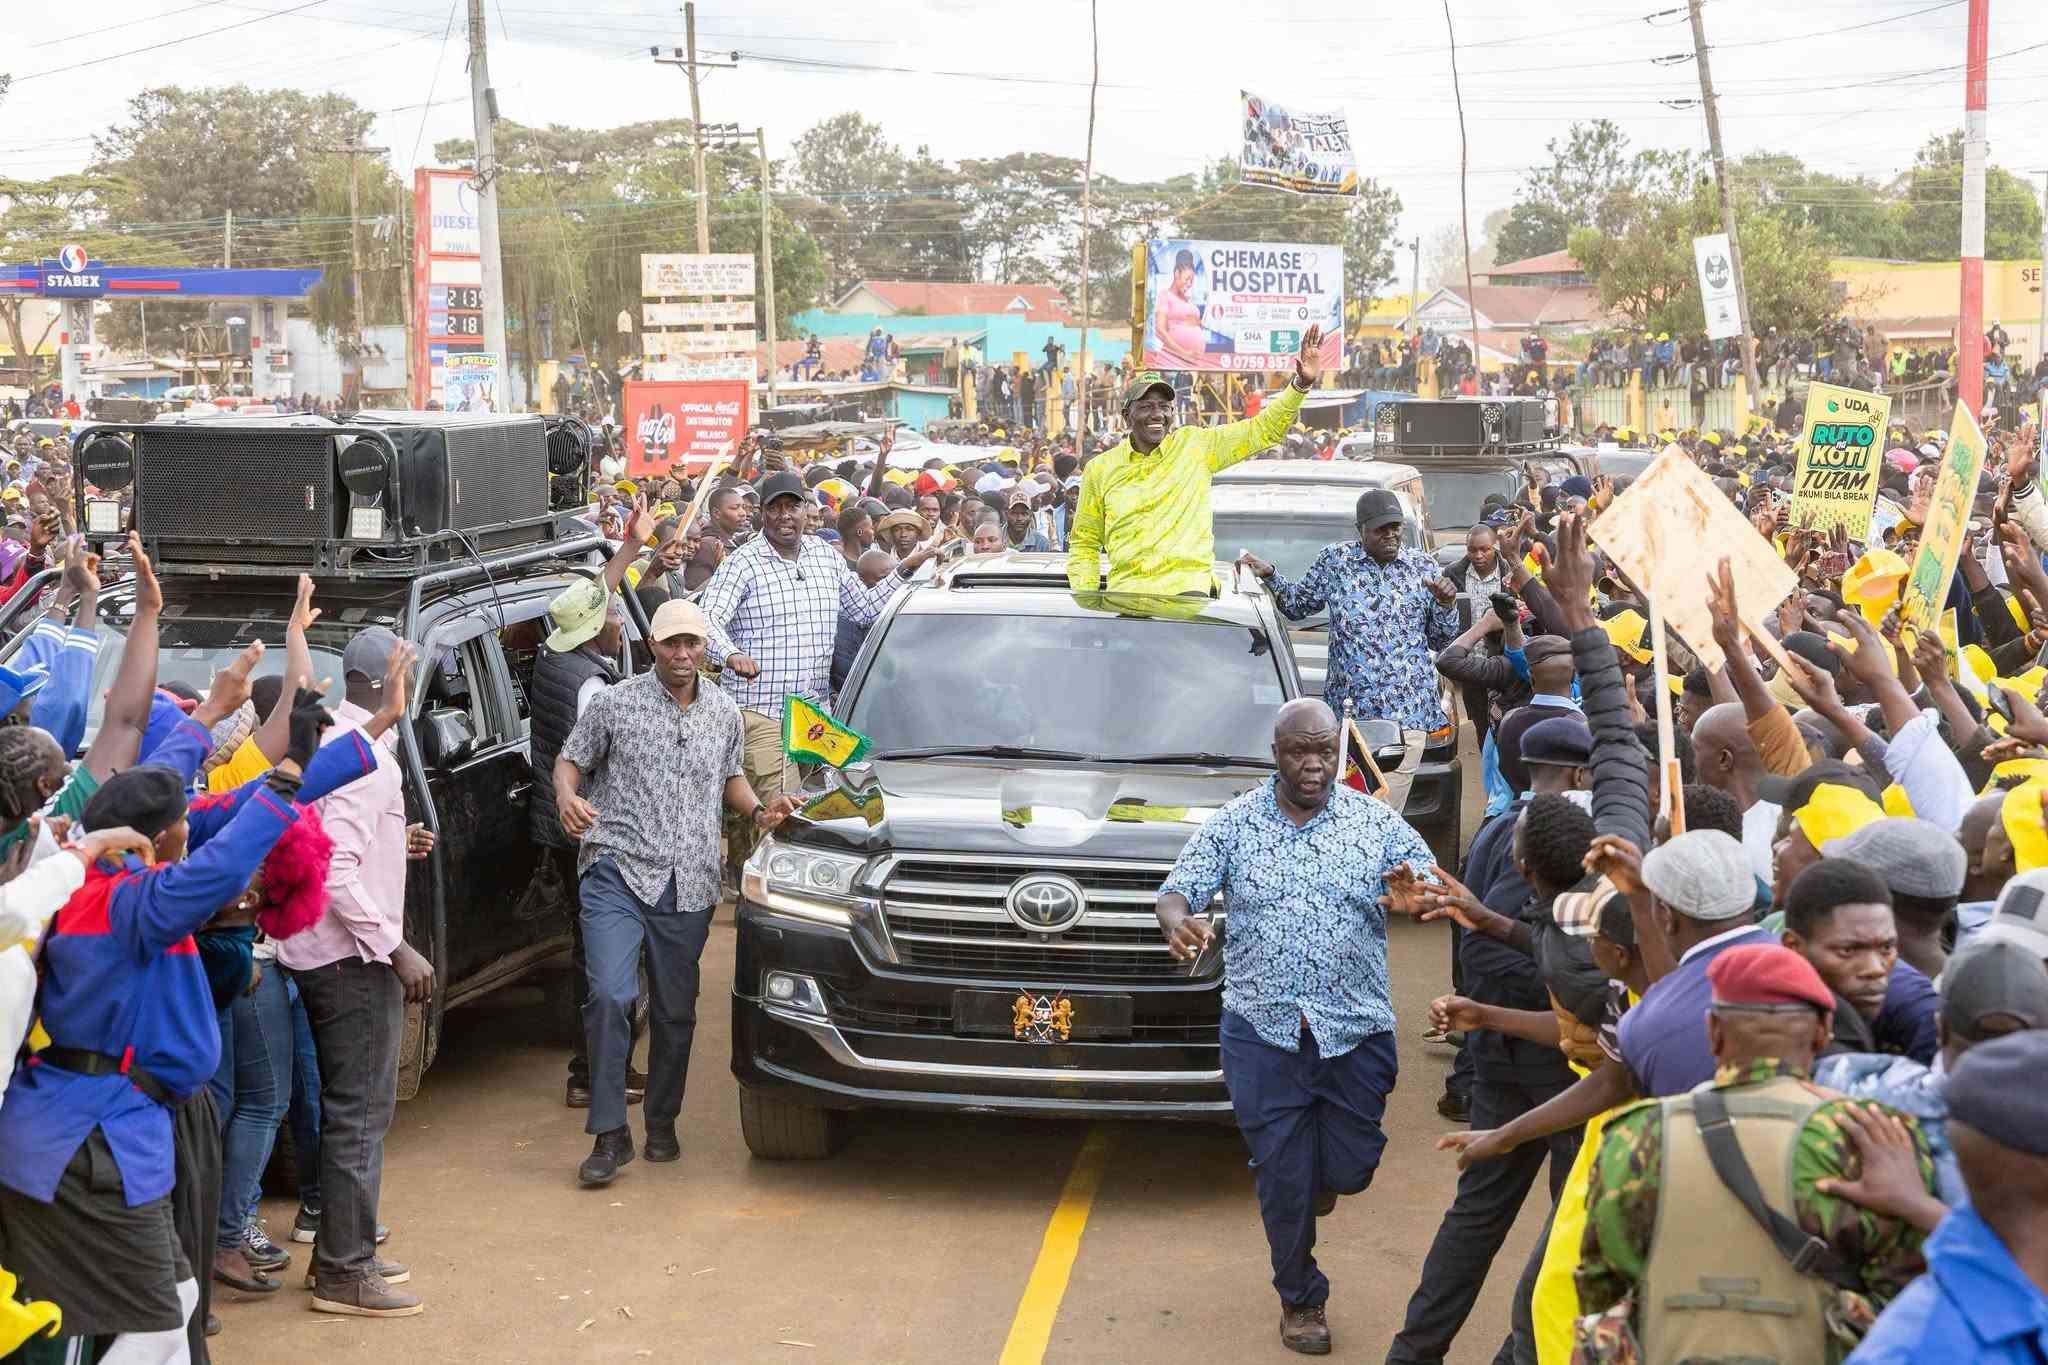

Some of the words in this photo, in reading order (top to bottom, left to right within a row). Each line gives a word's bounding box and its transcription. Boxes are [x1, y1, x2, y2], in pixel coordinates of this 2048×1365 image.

[432, 215, 481, 230] DIESE
[1211, 249, 1302, 270] CHEMASE
[47, 275, 100, 288] STABEX
[1212, 270, 1325, 294] HOSPITAL
[681, 403, 714, 413] OFFICIAL
[1844, 398, 1870, 413] UDA
[686, 416, 733, 427] DISTRIBUTOR
[1812, 424, 1874, 446] RUTO
[1810, 445, 1869, 467] KOTI
[1802, 470, 1870, 490] TUTAM
[1798, 490, 1823, 499] #KUMI
[1824, 490, 1841, 500] BILA
[1843, 492, 1869, 501] BREAK
